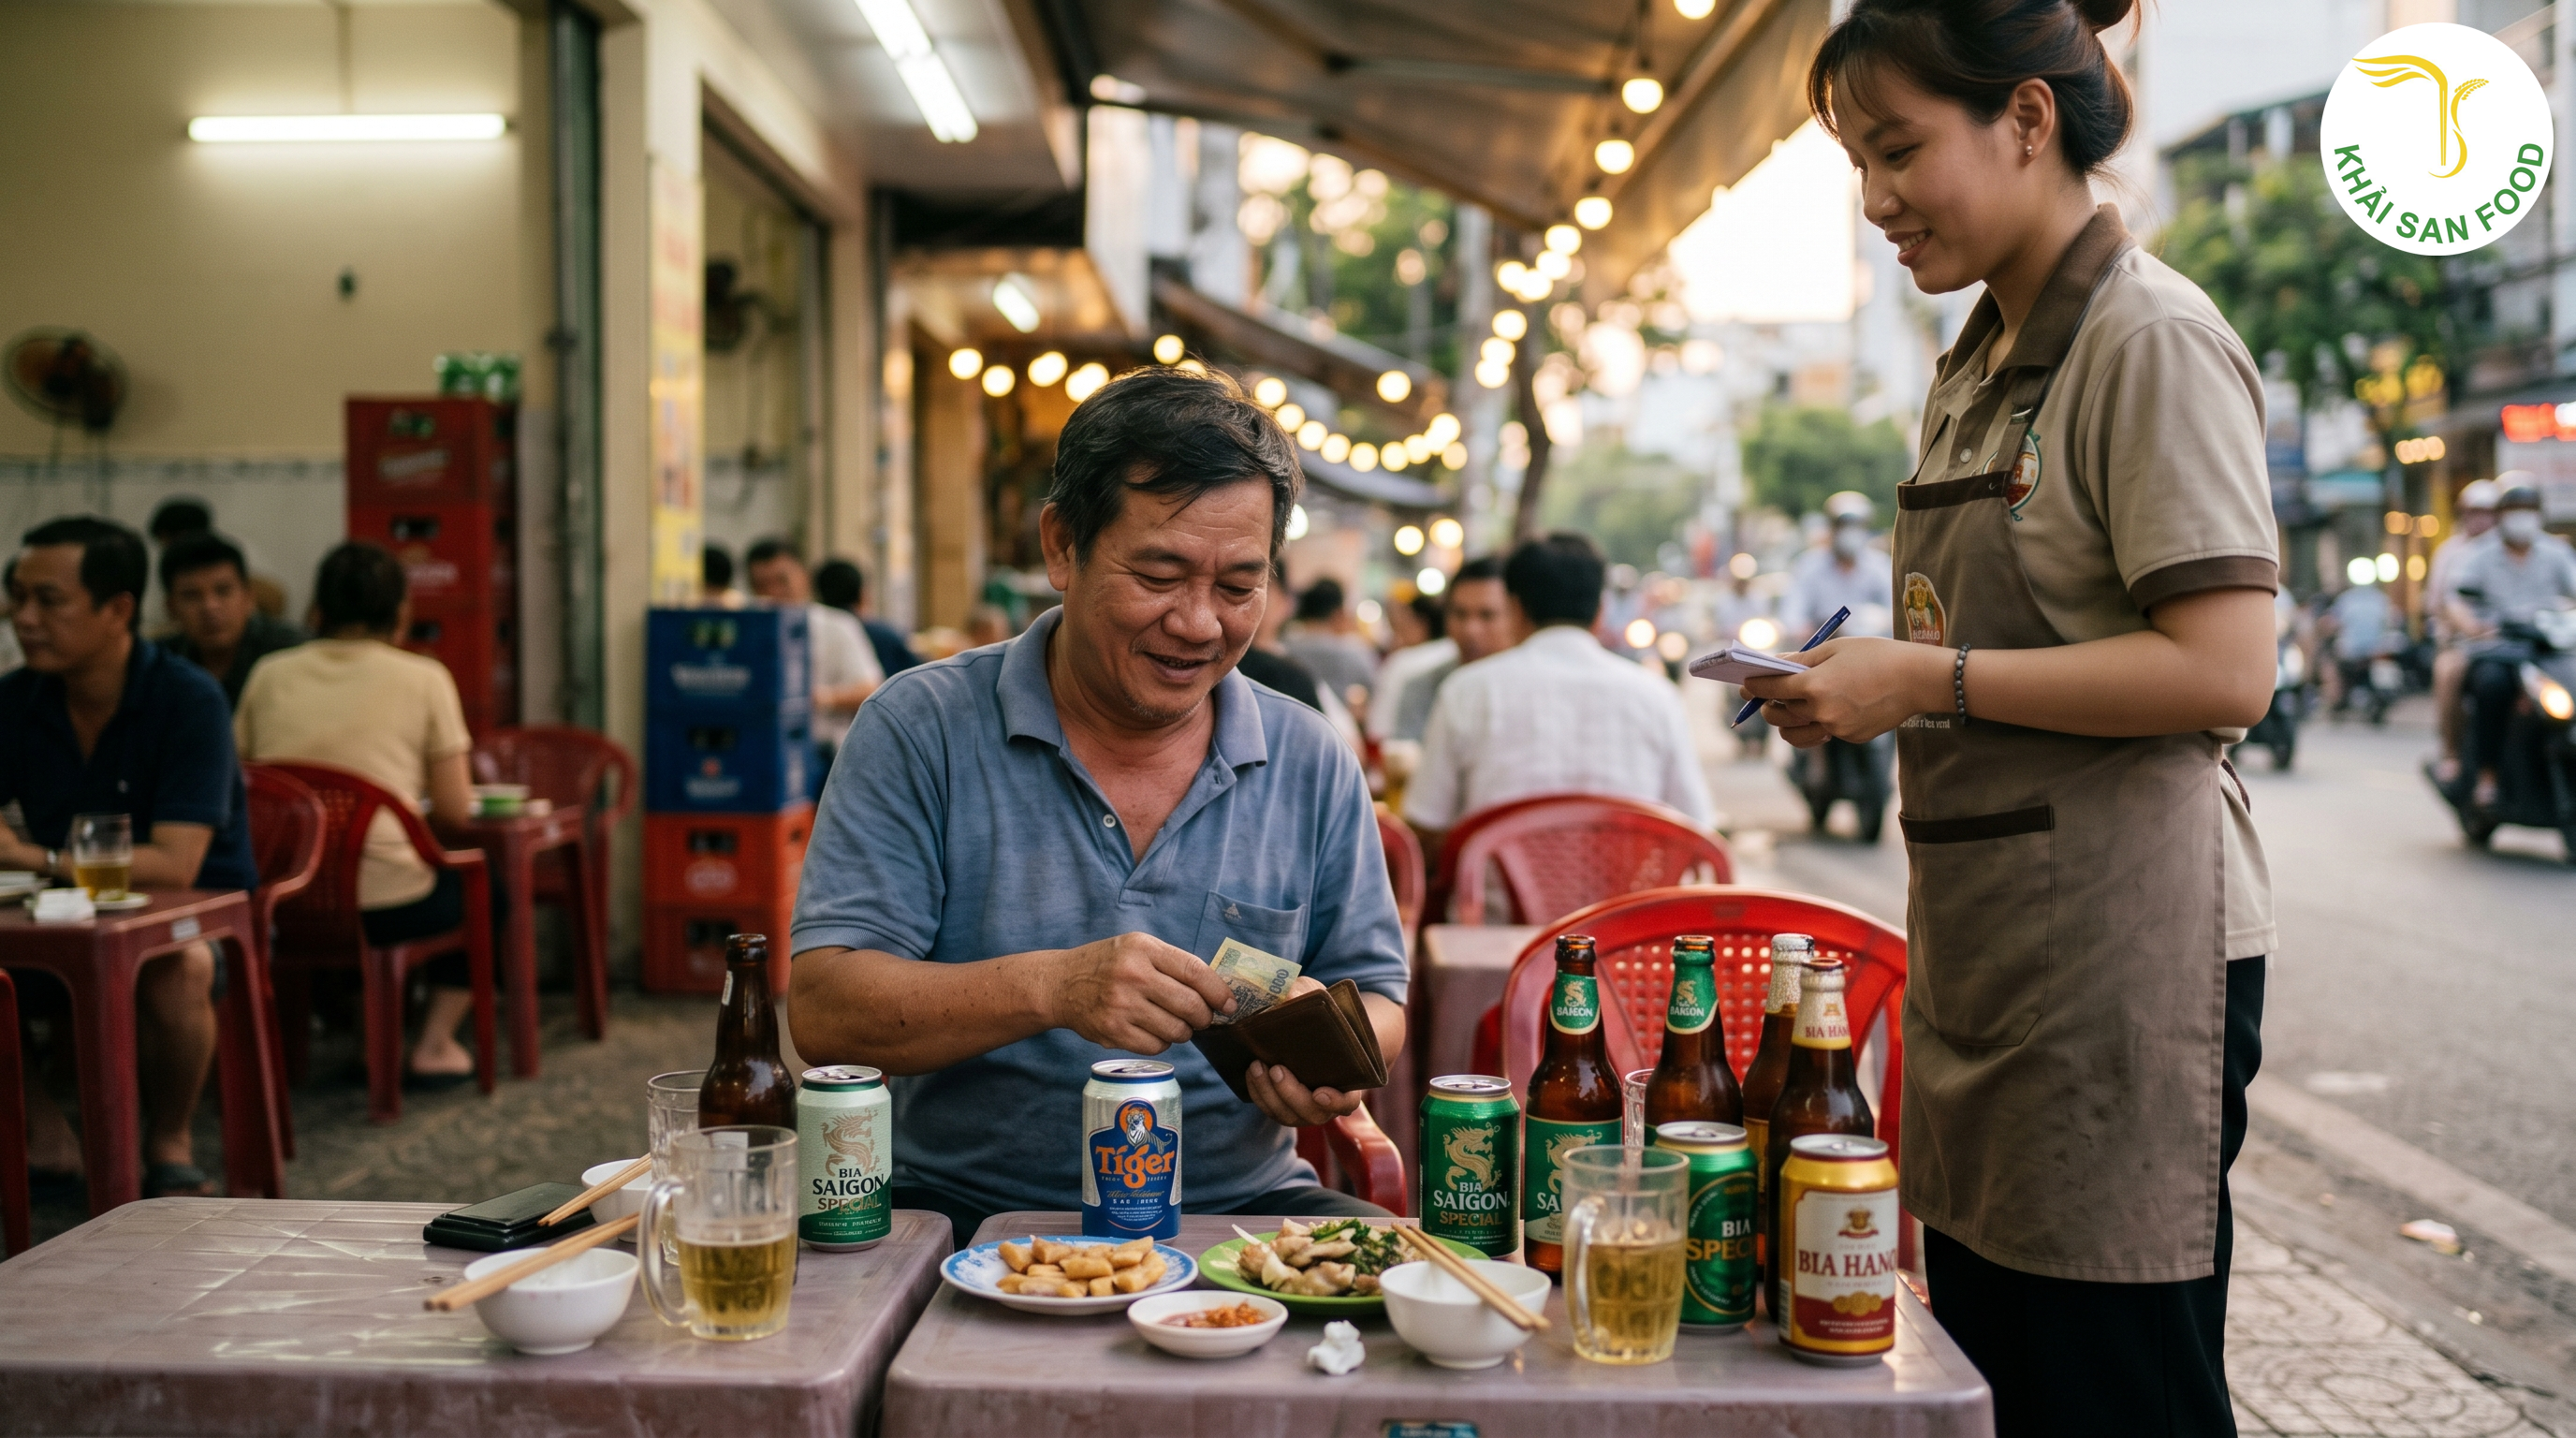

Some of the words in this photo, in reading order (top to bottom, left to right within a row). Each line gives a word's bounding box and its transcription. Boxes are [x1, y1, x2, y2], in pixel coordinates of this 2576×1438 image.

[1805, 1026, 1824, 1038] BIA
[839, 1167, 862, 1179] BIA
[1095, 1144, 1176, 1189] Tiger
[812, 1173, 884, 1196] SAIGON
[817, 1194, 882, 1214] SPECIAL
[1439, 1211, 1503, 1226] SPECIAL
[1721, 1218, 1751, 1238] BIA
[1798, 1249, 1837, 1277] BIA
